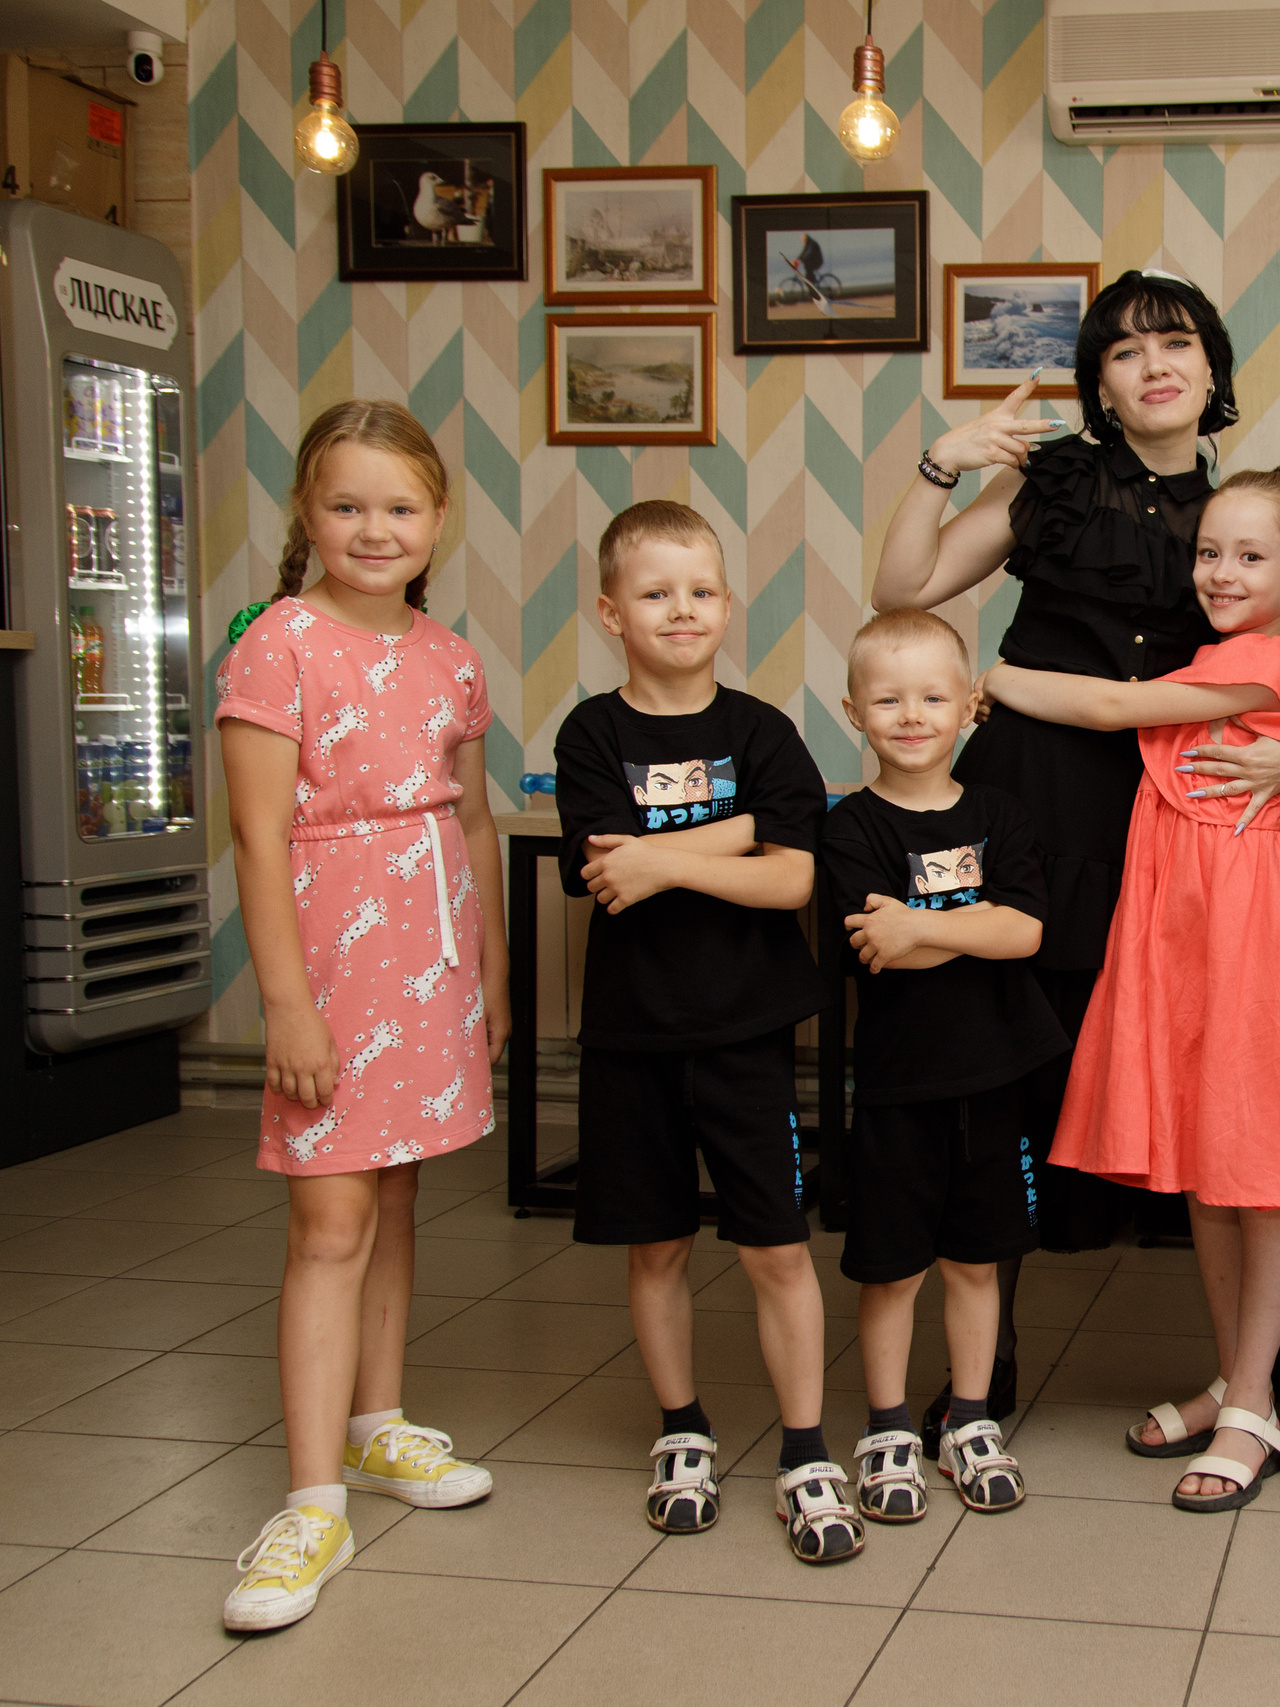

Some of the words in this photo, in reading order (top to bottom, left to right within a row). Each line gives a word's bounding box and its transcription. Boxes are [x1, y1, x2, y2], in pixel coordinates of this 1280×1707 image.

[69, 276, 166, 334] ЛІДСКАЕ
[639, 803, 710, 829] かった
